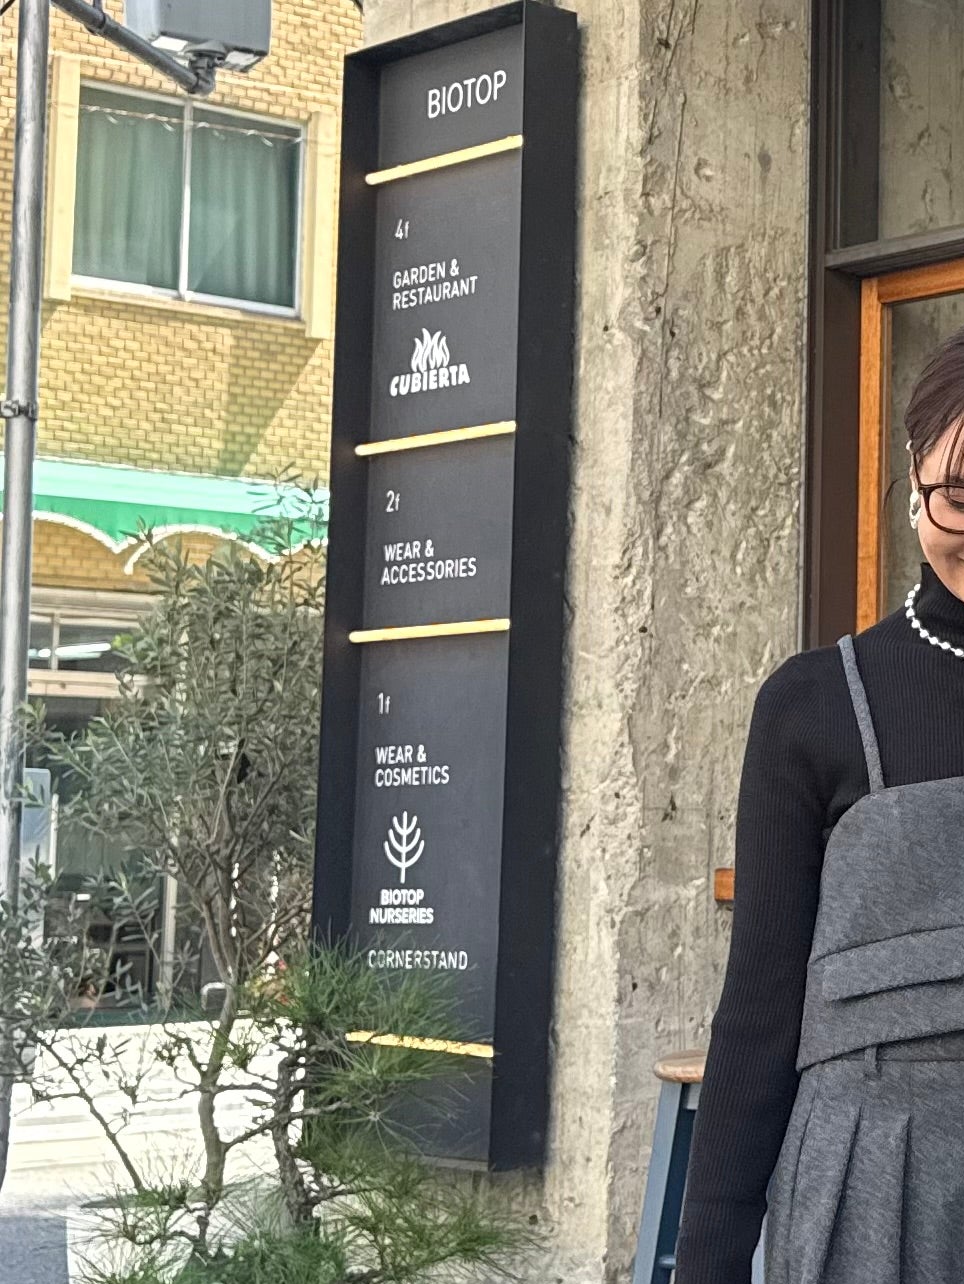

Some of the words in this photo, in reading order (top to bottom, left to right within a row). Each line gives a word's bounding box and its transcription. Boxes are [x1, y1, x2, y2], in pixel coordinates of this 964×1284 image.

[427, 69, 507, 119] BIOTOP
[393, 260, 446, 290] GARDEN
[449, 258, 460, 277] &
[392, 275, 478, 311] RESTAURANT
[389, 363, 471, 397] CUBIERTA
[384, 540, 421, 562] WEAR
[425, 539, 434, 558] &
[381, 557, 477, 585] ACCESSORIES
[375, 744, 414, 765] WEAR
[417, 744, 427, 763] &
[375, 765, 450, 788] COSMETICS
[380, 888, 425, 906] BIOTOP
[369, 907, 435, 924] NURSERIES
[367, 949, 469, 970] CORNERSTAND
